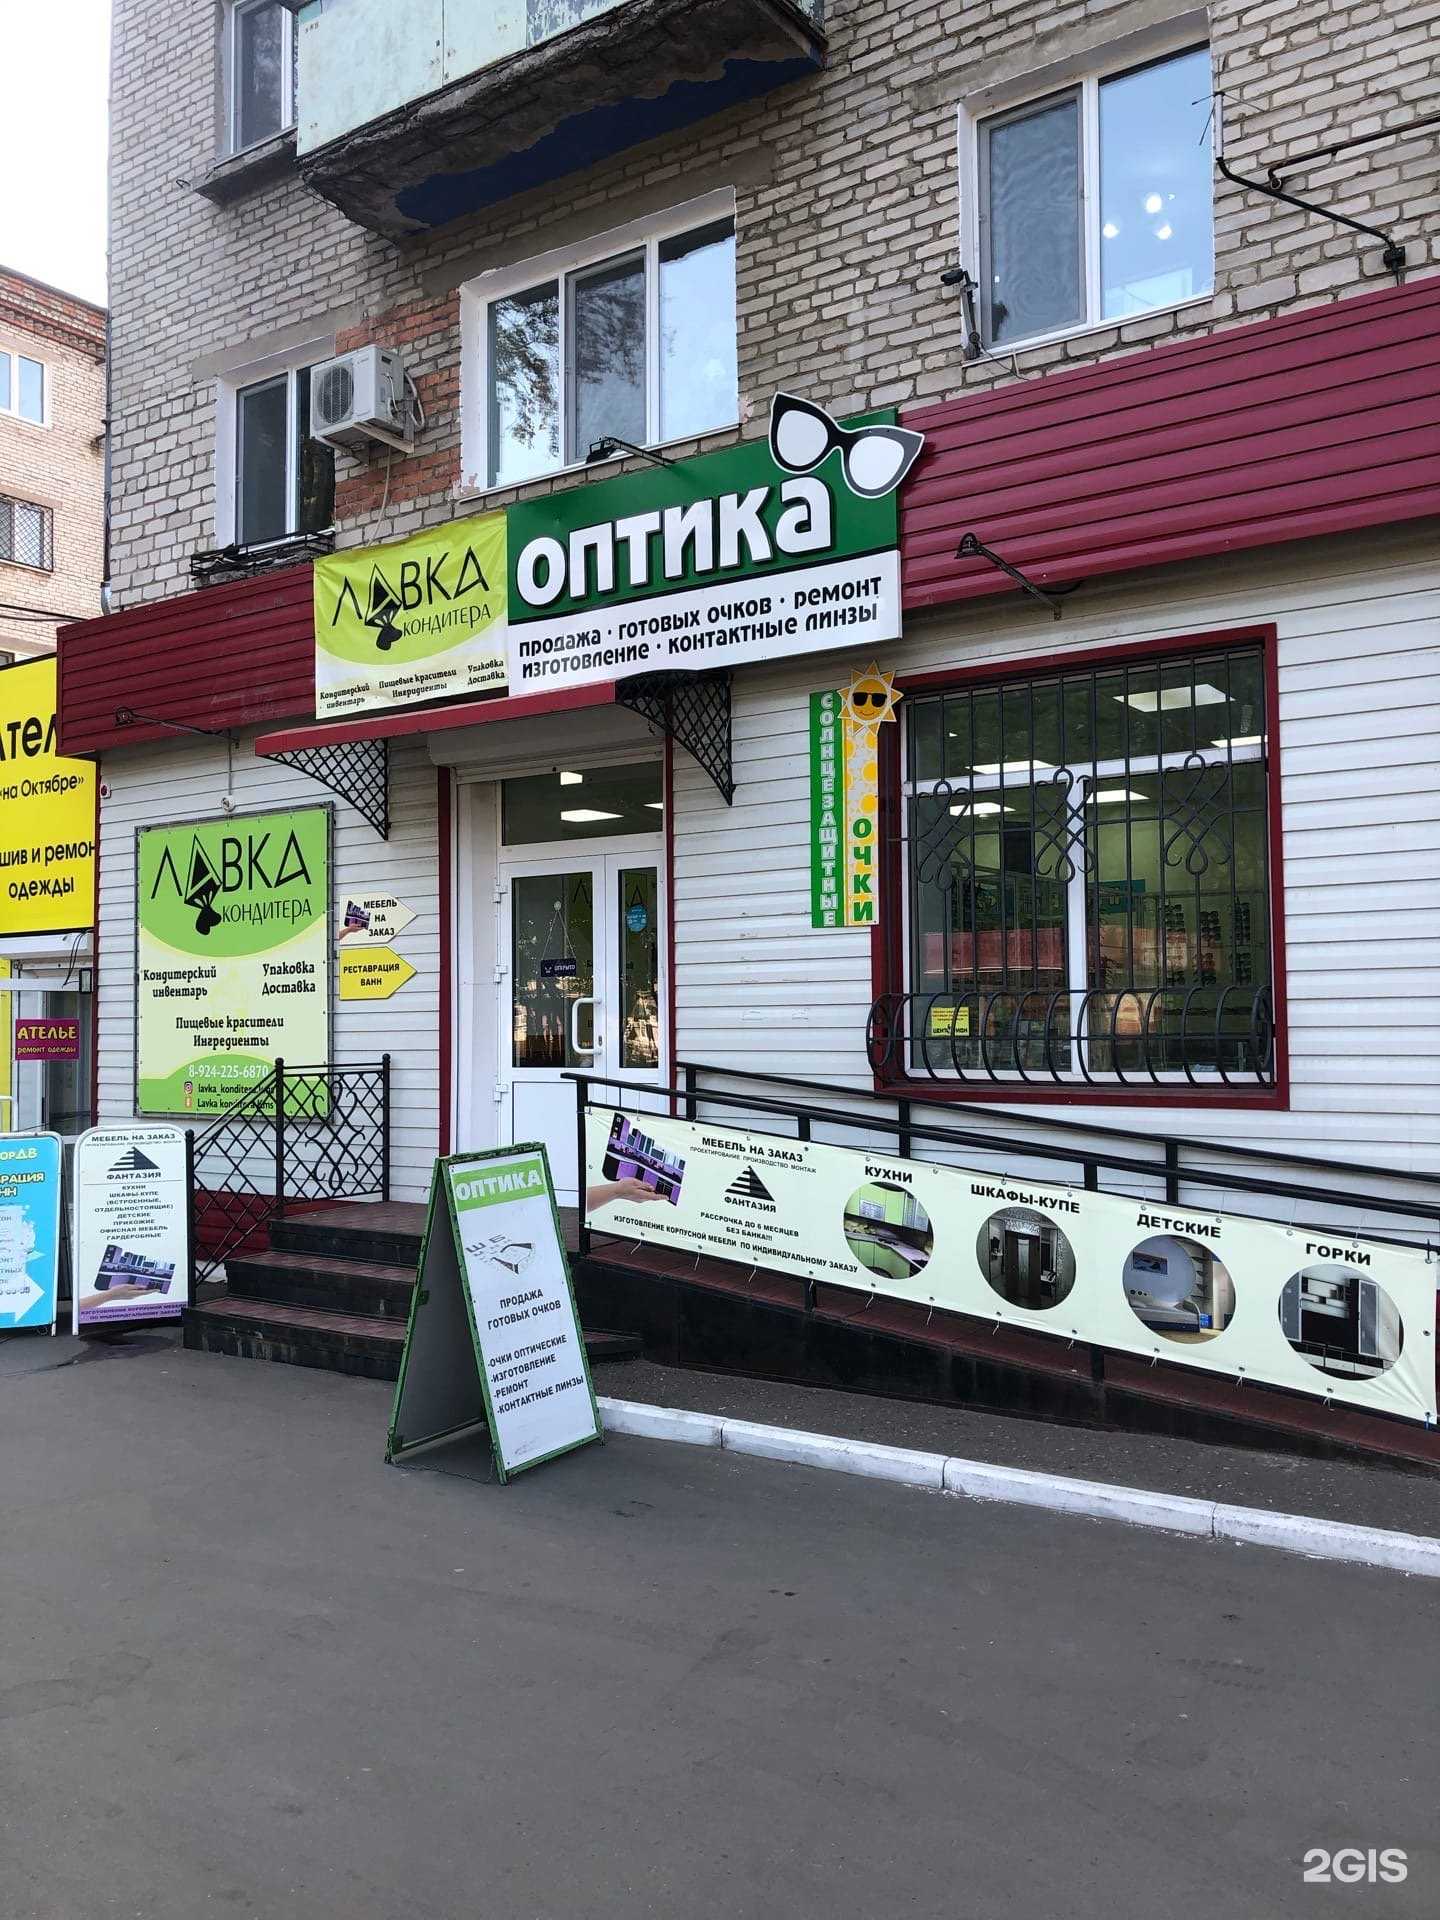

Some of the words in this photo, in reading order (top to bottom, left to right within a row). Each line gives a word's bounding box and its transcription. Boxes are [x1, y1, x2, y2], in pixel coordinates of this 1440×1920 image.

[332, 546, 490, 628] ЛАВКА
[402, 602, 491, 639] КОНДИТЕРА
[519, 629, 601, 659] продажа
[618, 609, 700, 644] готовых
[707, 596, 771, 627] очков
[794, 576, 882, 608] ремонт
[522, 643, 649, 679] изготовление
[668, 617, 798, 654] контактные
[805, 602, 877, 633] линзы
[467, 659, 504, 673] Упаковка
[379, 676, 413, 689] Пищевые
[415, 669, 457, 684] красители
[468, 671, 505, 685] Доставка
[320, 683, 370, 699] Кондитерский
[326, 697, 365, 709] инвентарь
[32, 847, 40, 863] и
[151, 830, 311, 900] ЛАВКА
[852, 818, 873, 922] ОЧКИ
[9, 877, 74, 900] одежды
[223, 898, 312, 925] КОНДИТЕРА
[363, 899, 398, 909] МЕБЕЛЬ
[374, 914, 386, 922] НА
[368, 928, 395, 937] ЗАКАЗ
[143, 965, 217, 984] Кондитерский
[263, 961, 315, 976] Упаковка
[343, 964, 400, 974] РЕСТАВРАЦИЯ
[262, 980, 316, 996] Доставка
[360, 978, 382, 986] ВАНН
[152, 986, 208, 1000] инвентарь
[17, 1026, 77, 1040] АТЕЛЬЕ
[176, 1017, 224, 1030] Пищевые
[226, 1015, 284, 1032] красители
[18, 1047, 45, 1055] ремонт
[194, 1035, 269, 1050] Ингредиенты
[188, 1064, 269, 1079] 8-924-225-6870
[197, 1098, 218, 1108] Lavka
[702, 1137, 746, 1152] МЕБЕЛЬ
[749, 1145, 765, 1156] НА
[767, 1148, 803, 1162] ЗАКАЗ
[689, 1146, 741, 1160] ПРОЕКТИРОВАНИЕ
[743, 1156, 789, 1169] ПРОИЗВОДСТВО
[790, 1164, 817, 1173] МОНТАЖ
[106, 1172, 162, 1180] ФАНТАЗИЯ
[864, 1164, 913, 1184] КУХНИ
[456, 1169, 543, 1200] ОПТИКА
[724, 1196, 777, 1213] ФАНТАЗИЯ
[971, 1183, 1080, 1214] ШКАФЫ-КУПЕ
[700, 1211, 743, 1226] РАССРОЧКА
[745, 1220, 756, 1229] ДО
[763, 1224, 799, 1237] МЕСЯЦЕВ
[726, 1227, 740, 1235] БЕЗ
[1136, 1213, 1222, 1238] ДЕТСКИЕ
[614, 1215, 665, 1232] ИЗГОТОВЛЕНИЕ
[666, 1225, 707, 1241] КОРПУСНОЙ
[708, 1234, 737, 1247] МЕБЕЛИ
[740, 1241, 751, 1250] ПО
[752, 1244, 827, 1268] ИНДИВИДУАЛЬНОМУ
[829, 1260, 858, 1273] ЗАКАЗУ
[1305, 1242, 1371, 1266] ГОРКИ
[499, 1288, 544, 1309] ПРОДАЖА
[487, 1310, 530, 1330] ГОТОВЫХ
[531, 1299, 561, 1319] ОЧКОВ
[513, 1334, 567, 1362] ОПТИЧЕСКИЕ
[555, 1375, 584, 1394] ЛИНЗЫ
